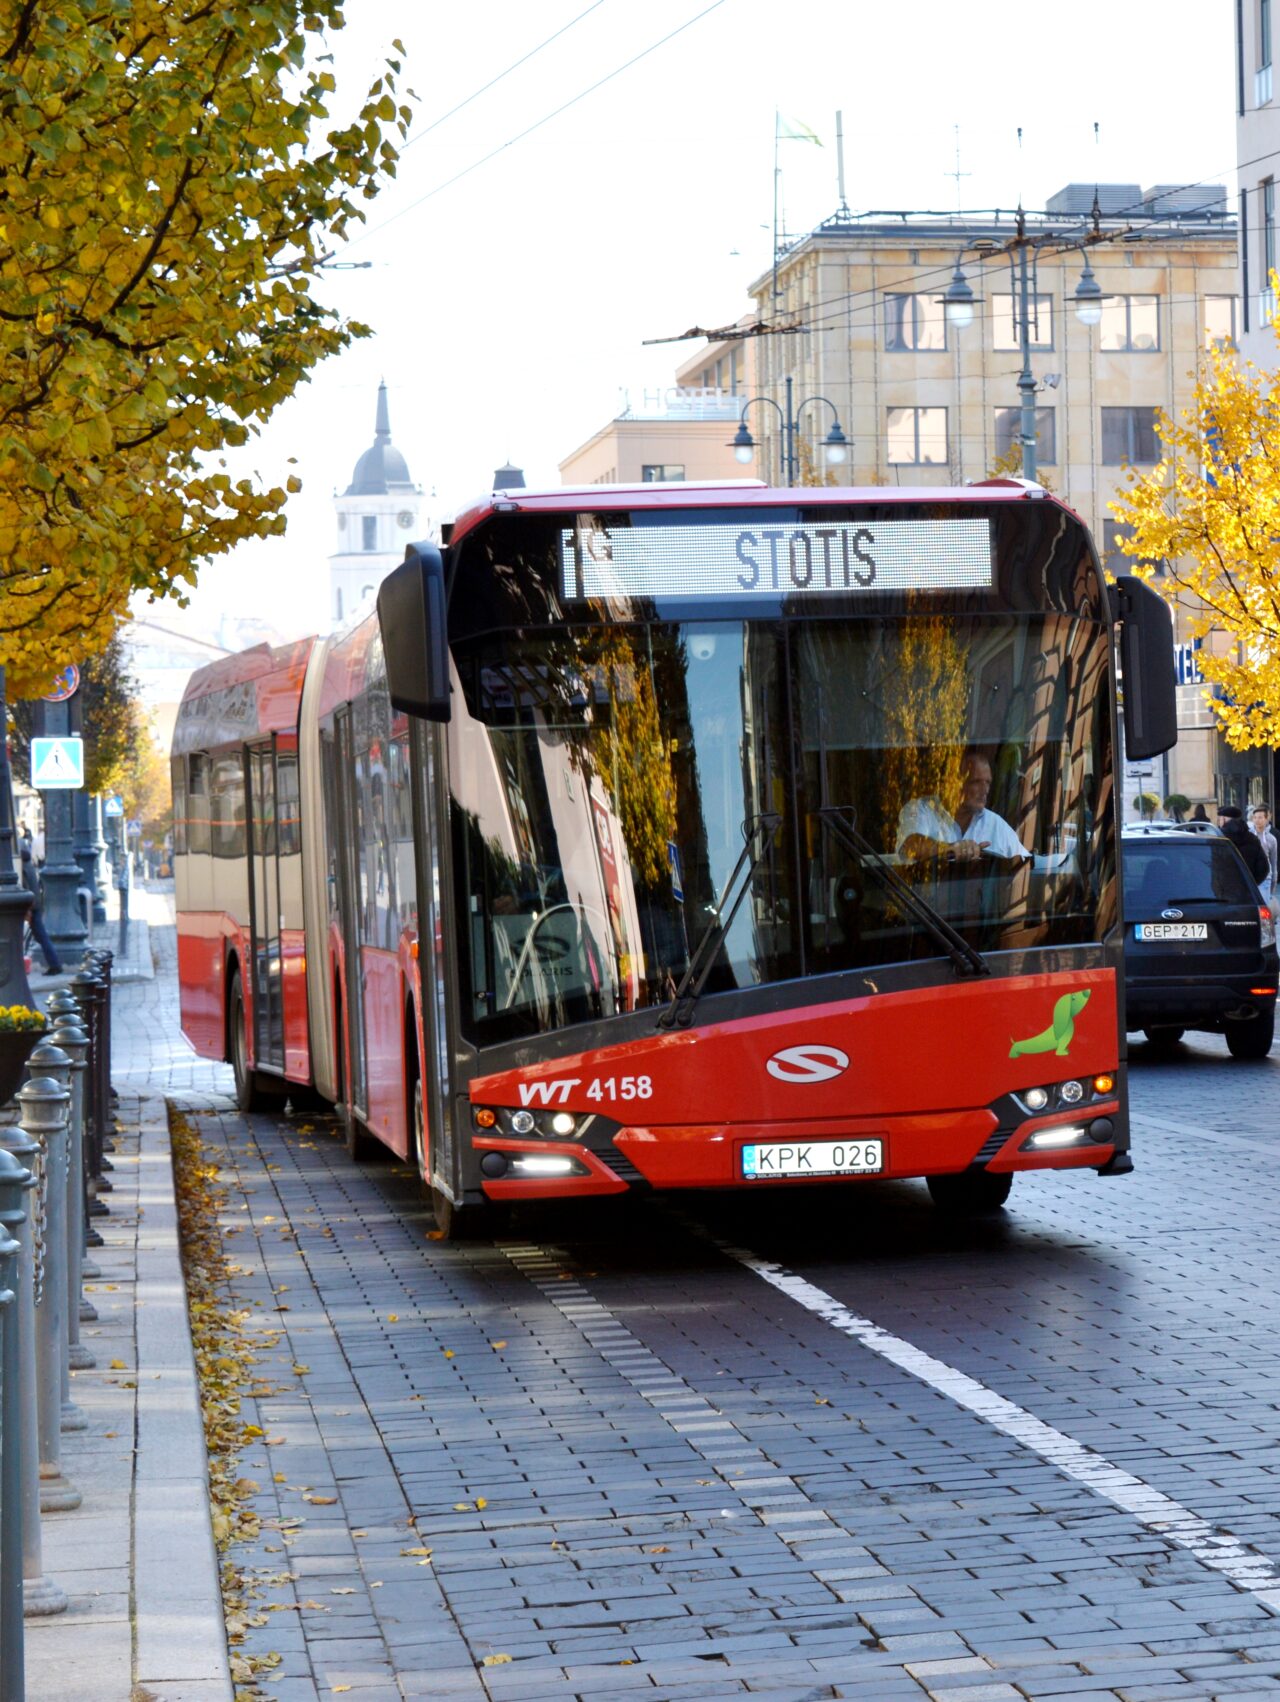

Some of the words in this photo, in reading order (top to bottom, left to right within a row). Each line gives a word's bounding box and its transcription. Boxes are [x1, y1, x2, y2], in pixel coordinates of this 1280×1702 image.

[735, 529, 877, 590] STOTIS
[1143, 925, 1172, 938] GEP
[1181, 925, 1205, 937] 217
[518, 1078, 582, 1106] VVT
[586, 1075, 653, 1102] 4158
[759, 1146, 812, 1170] KPK
[832, 1144, 877, 1167] 026
